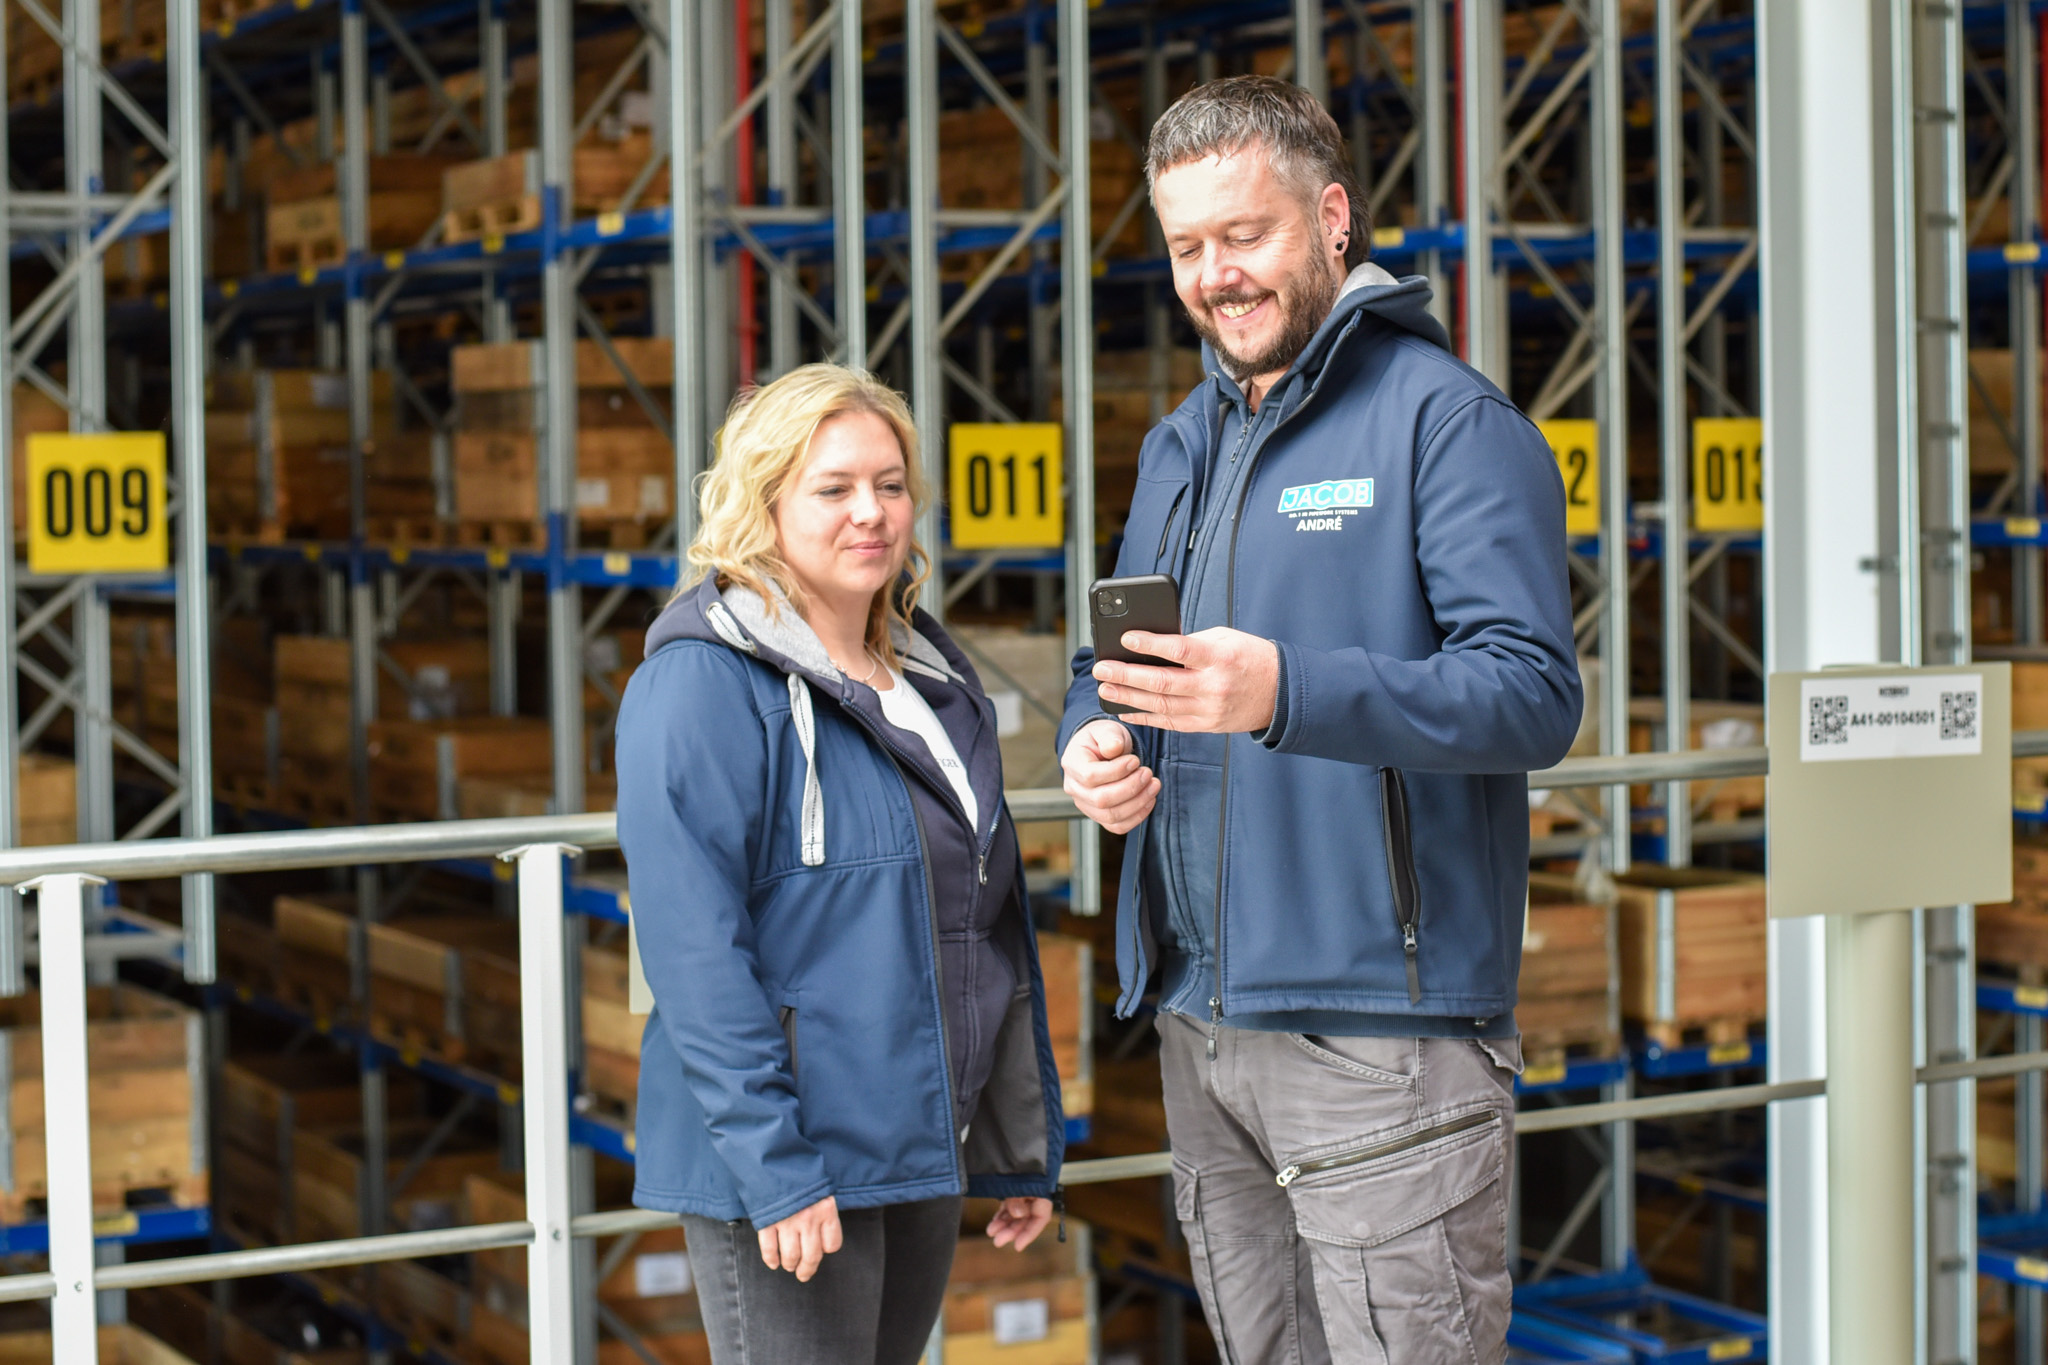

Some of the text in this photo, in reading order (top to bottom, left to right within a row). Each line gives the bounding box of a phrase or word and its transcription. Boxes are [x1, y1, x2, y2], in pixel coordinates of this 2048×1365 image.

[968, 454, 1047, 518] 011
[1283, 482, 1370, 509] JACOB
[45, 467, 150, 538] 009
[1296, 515, 1343, 532] ANDRÉ
[1850, 710, 1936, 727] A41-00104501
